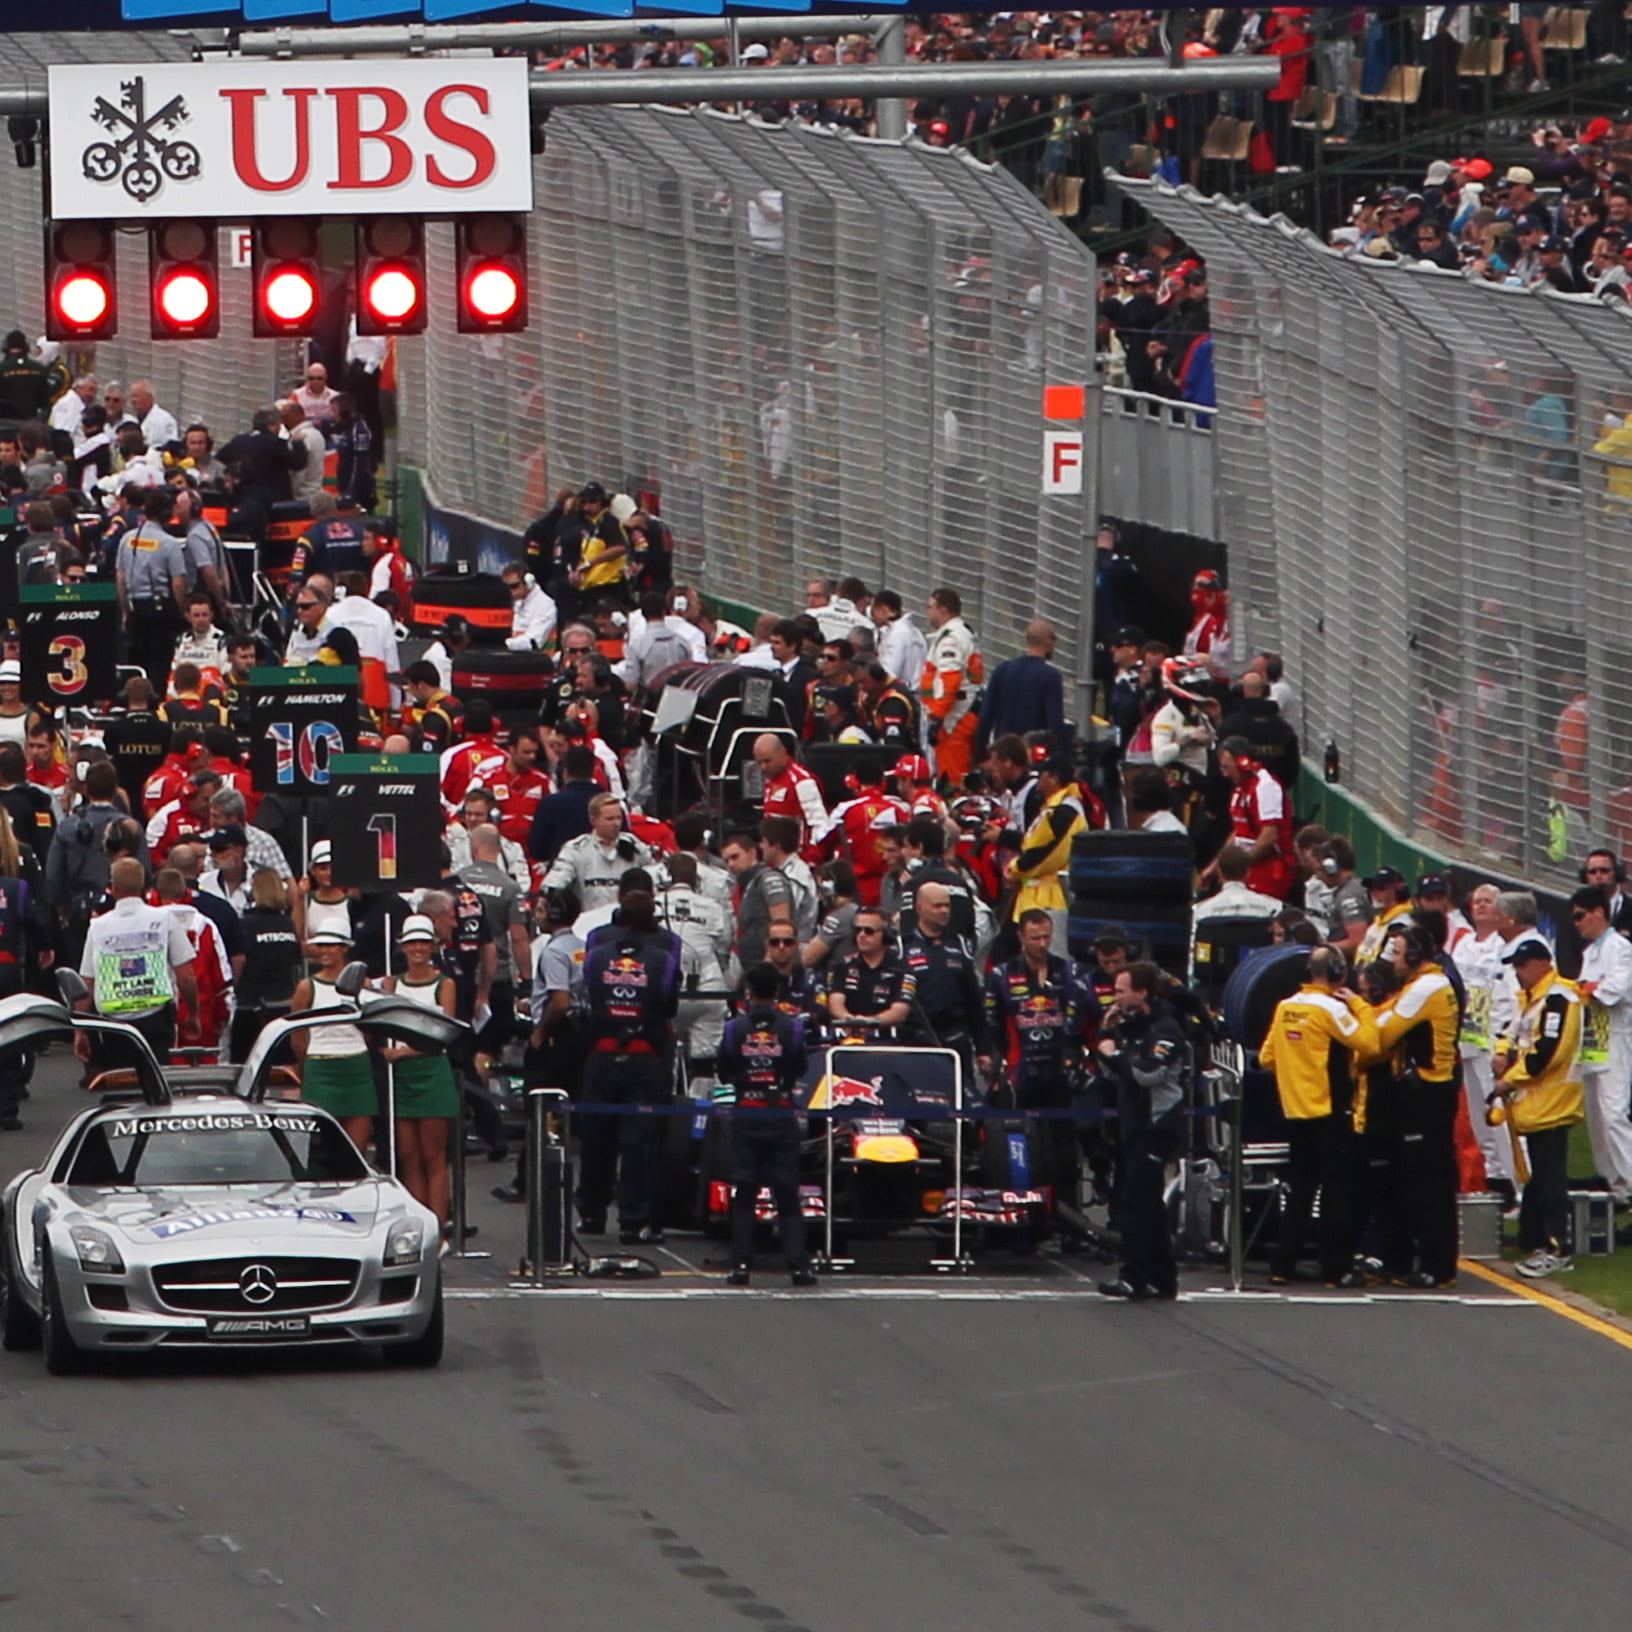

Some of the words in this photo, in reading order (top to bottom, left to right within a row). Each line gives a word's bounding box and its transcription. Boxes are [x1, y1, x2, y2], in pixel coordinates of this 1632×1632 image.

[221, 84, 496, 192] UBS
[1053, 442, 1081, 483] F
[56, 610, 101, 621] ALONSO
[47, 635, 88, 696] 3
[288, 677, 319, 685] ROLEX
[284, 694, 347, 706] HAMILTON
[119, 744, 163, 755] LOTUS
[265, 721, 345, 785] 10
[370, 764, 400, 773] ROLEX
[378, 784, 417, 796] VETTEL
[367, 814, 397, 879] 1
[112, 1113, 321, 1138] Mercedes-Benz
[167, 1207, 300, 1236] Allianz
[245, 1319, 307, 1332] AMG
